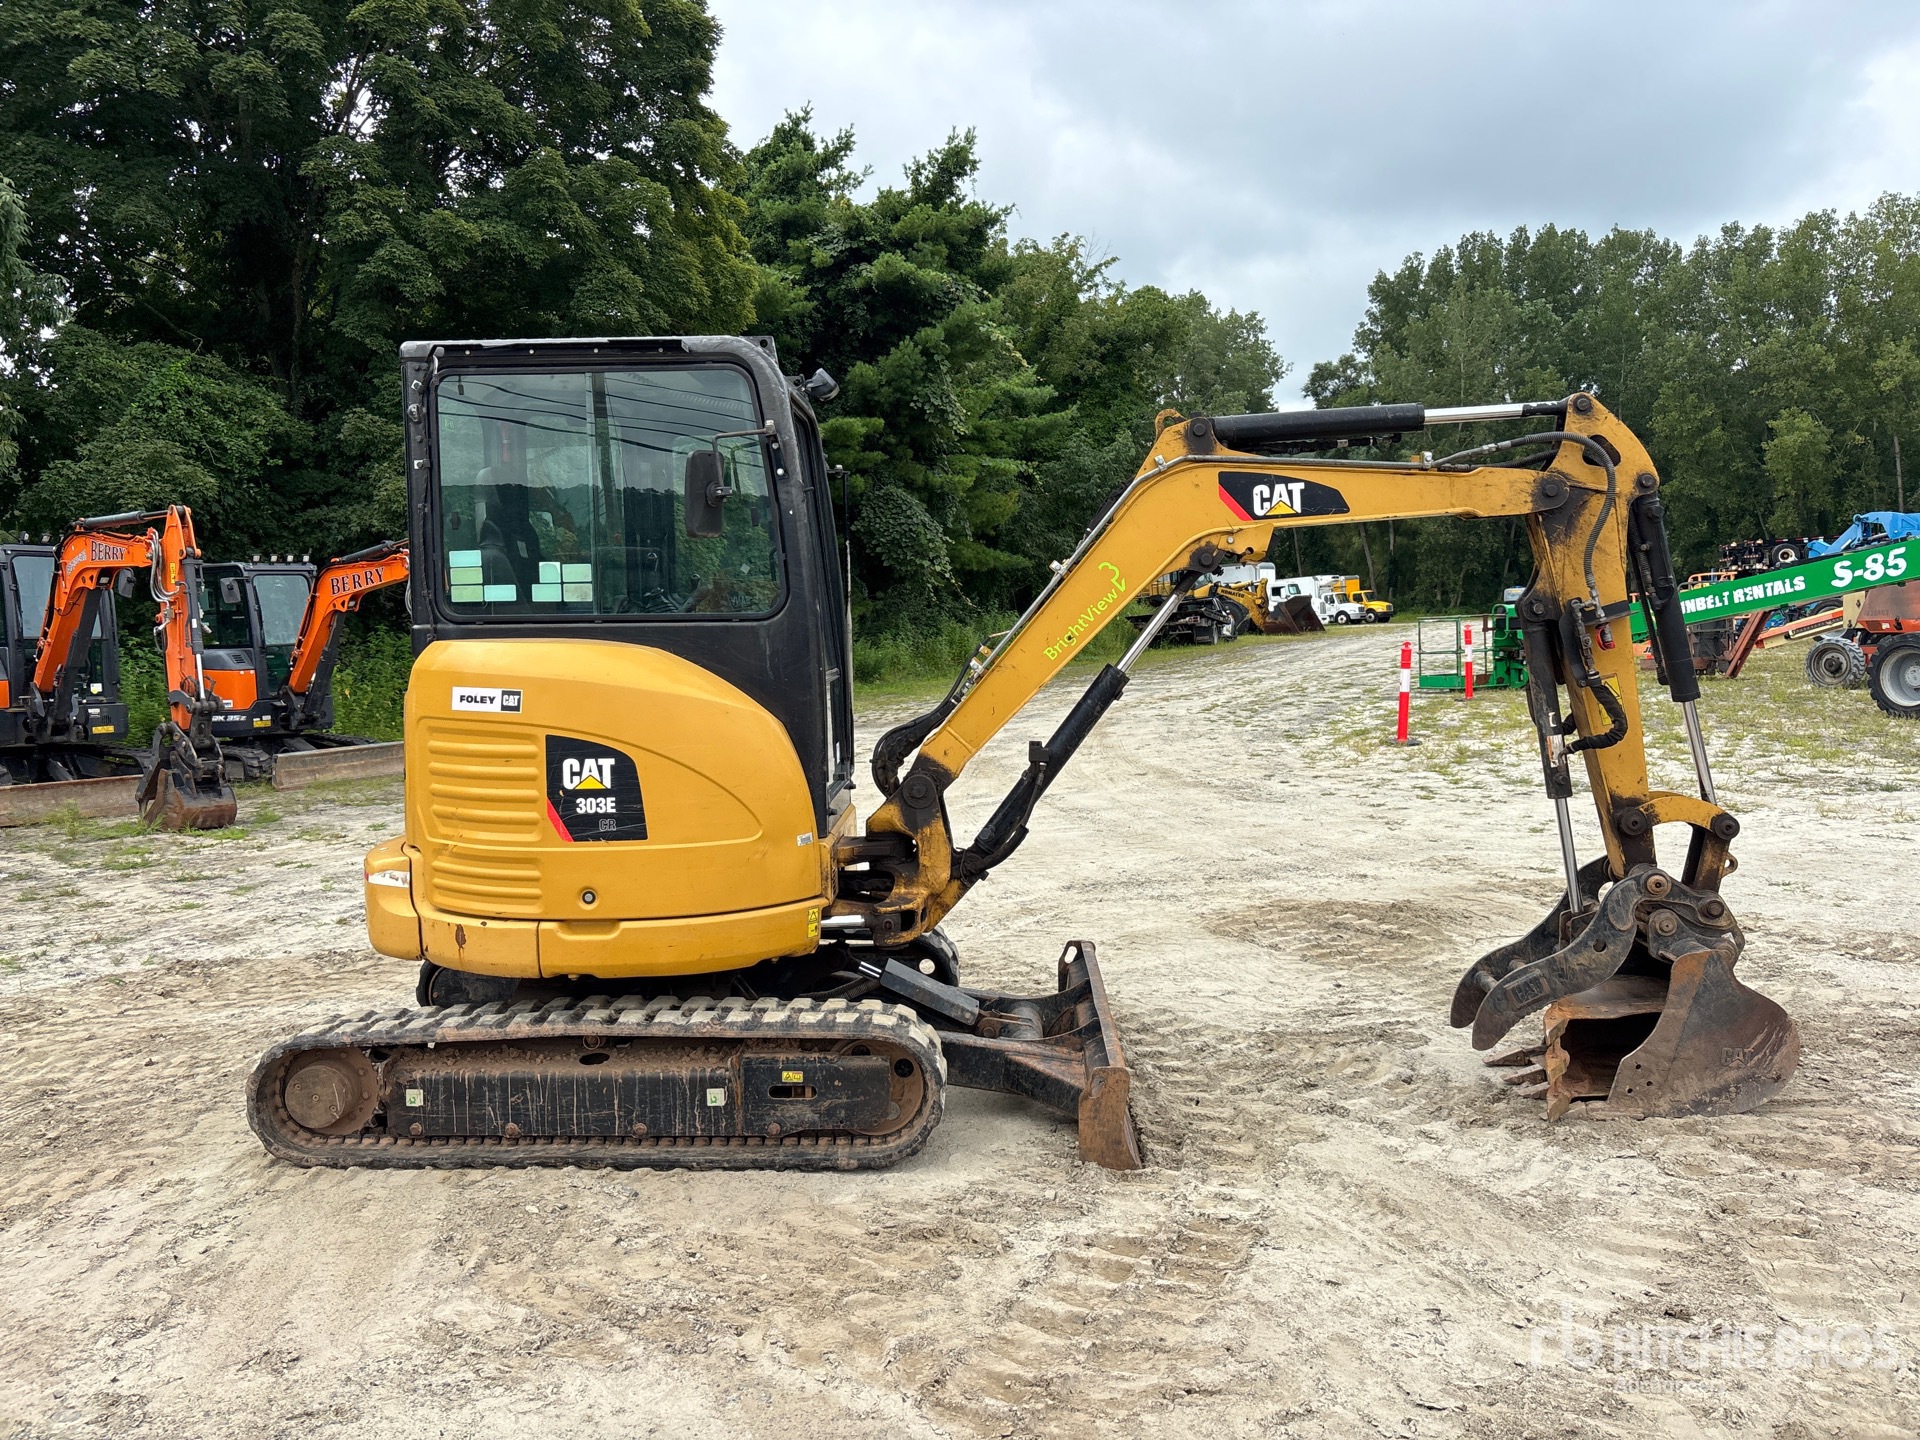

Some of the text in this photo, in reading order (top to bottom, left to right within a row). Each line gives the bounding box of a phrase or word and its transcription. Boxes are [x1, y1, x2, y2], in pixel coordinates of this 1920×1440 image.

[1252, 481, 1305, 517] CAT
[91, 540, 126, 561] BERRY
[330, 566, 384, 595] BERRY
[1831, 547, 1908, 588] S-85
[1733, 575, 1806, 605] RENTALS
[1043, 588, 1118, 660] BrightView
[459, 694, 520, 707] FOLEY CAT
[562, 757, 616, 790] CAT
[575, 796, 617, 814] 303E
[598, 818, 617, 832] CR
